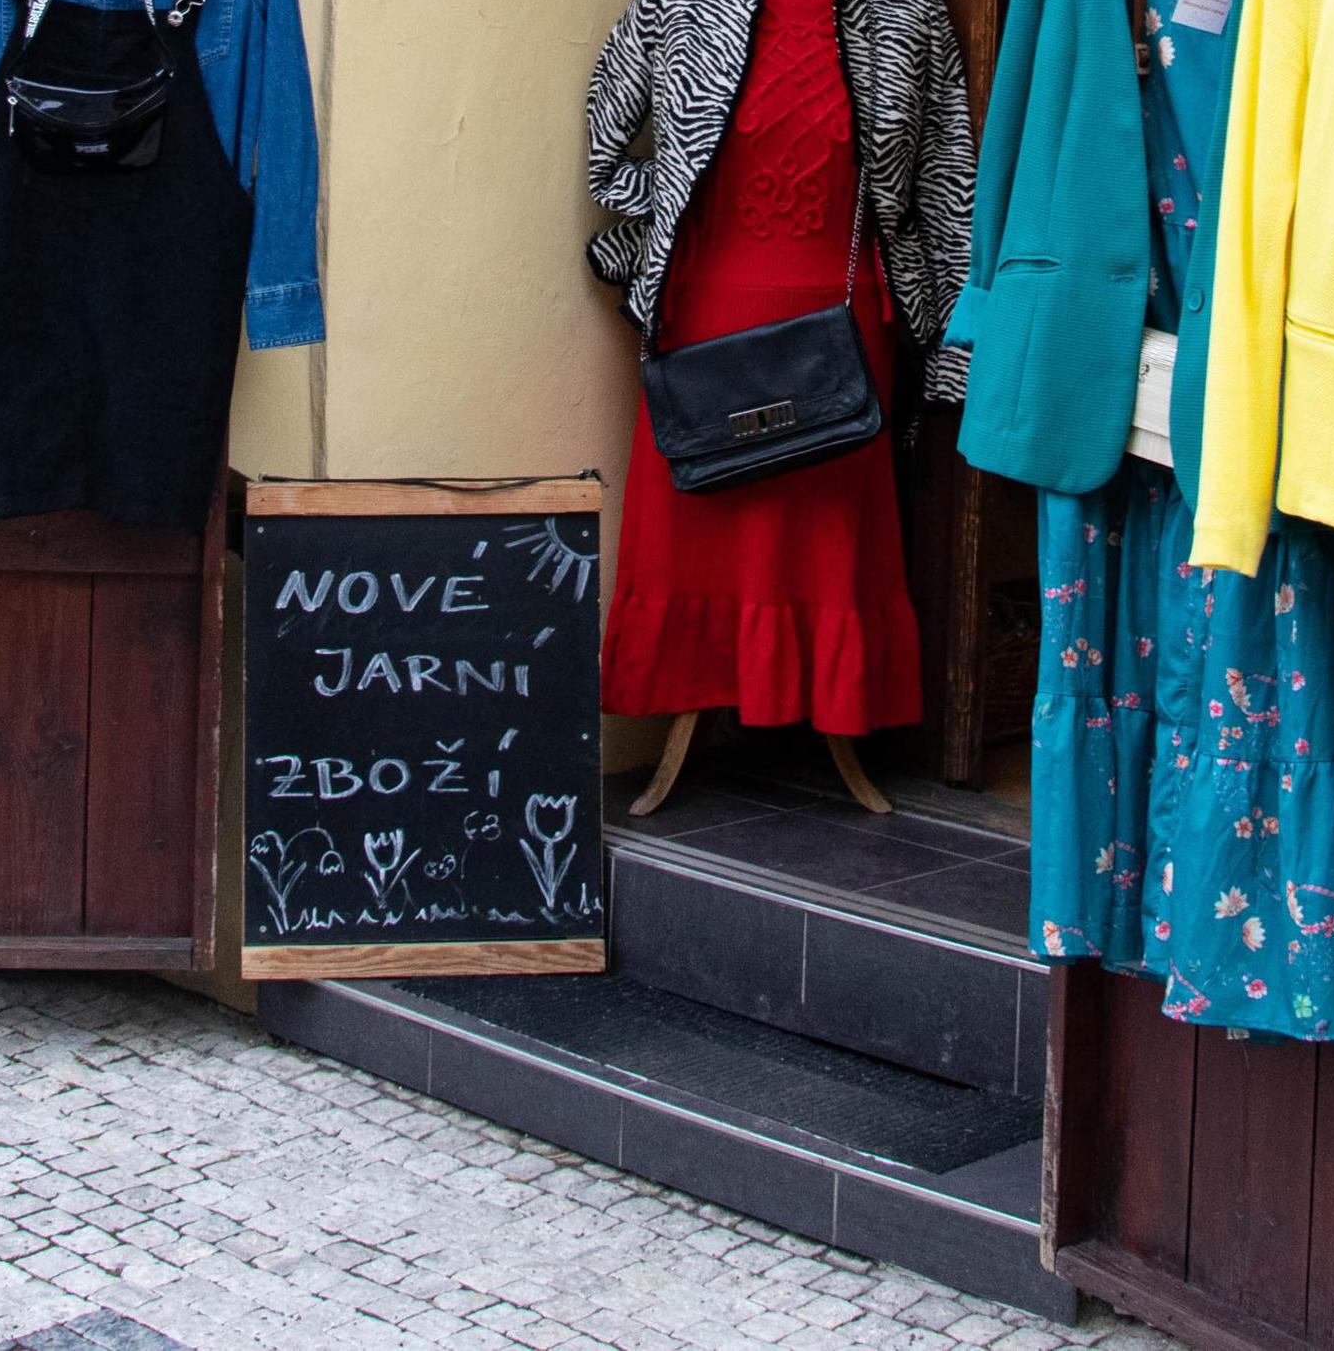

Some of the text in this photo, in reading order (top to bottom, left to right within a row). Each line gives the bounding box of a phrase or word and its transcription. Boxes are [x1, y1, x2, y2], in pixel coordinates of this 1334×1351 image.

[275, 540, 491, 614] NOVÉ
[313, 625, 556, 698] JARNÍ
[263, 727, 519, 800] ZBOŽÍ
